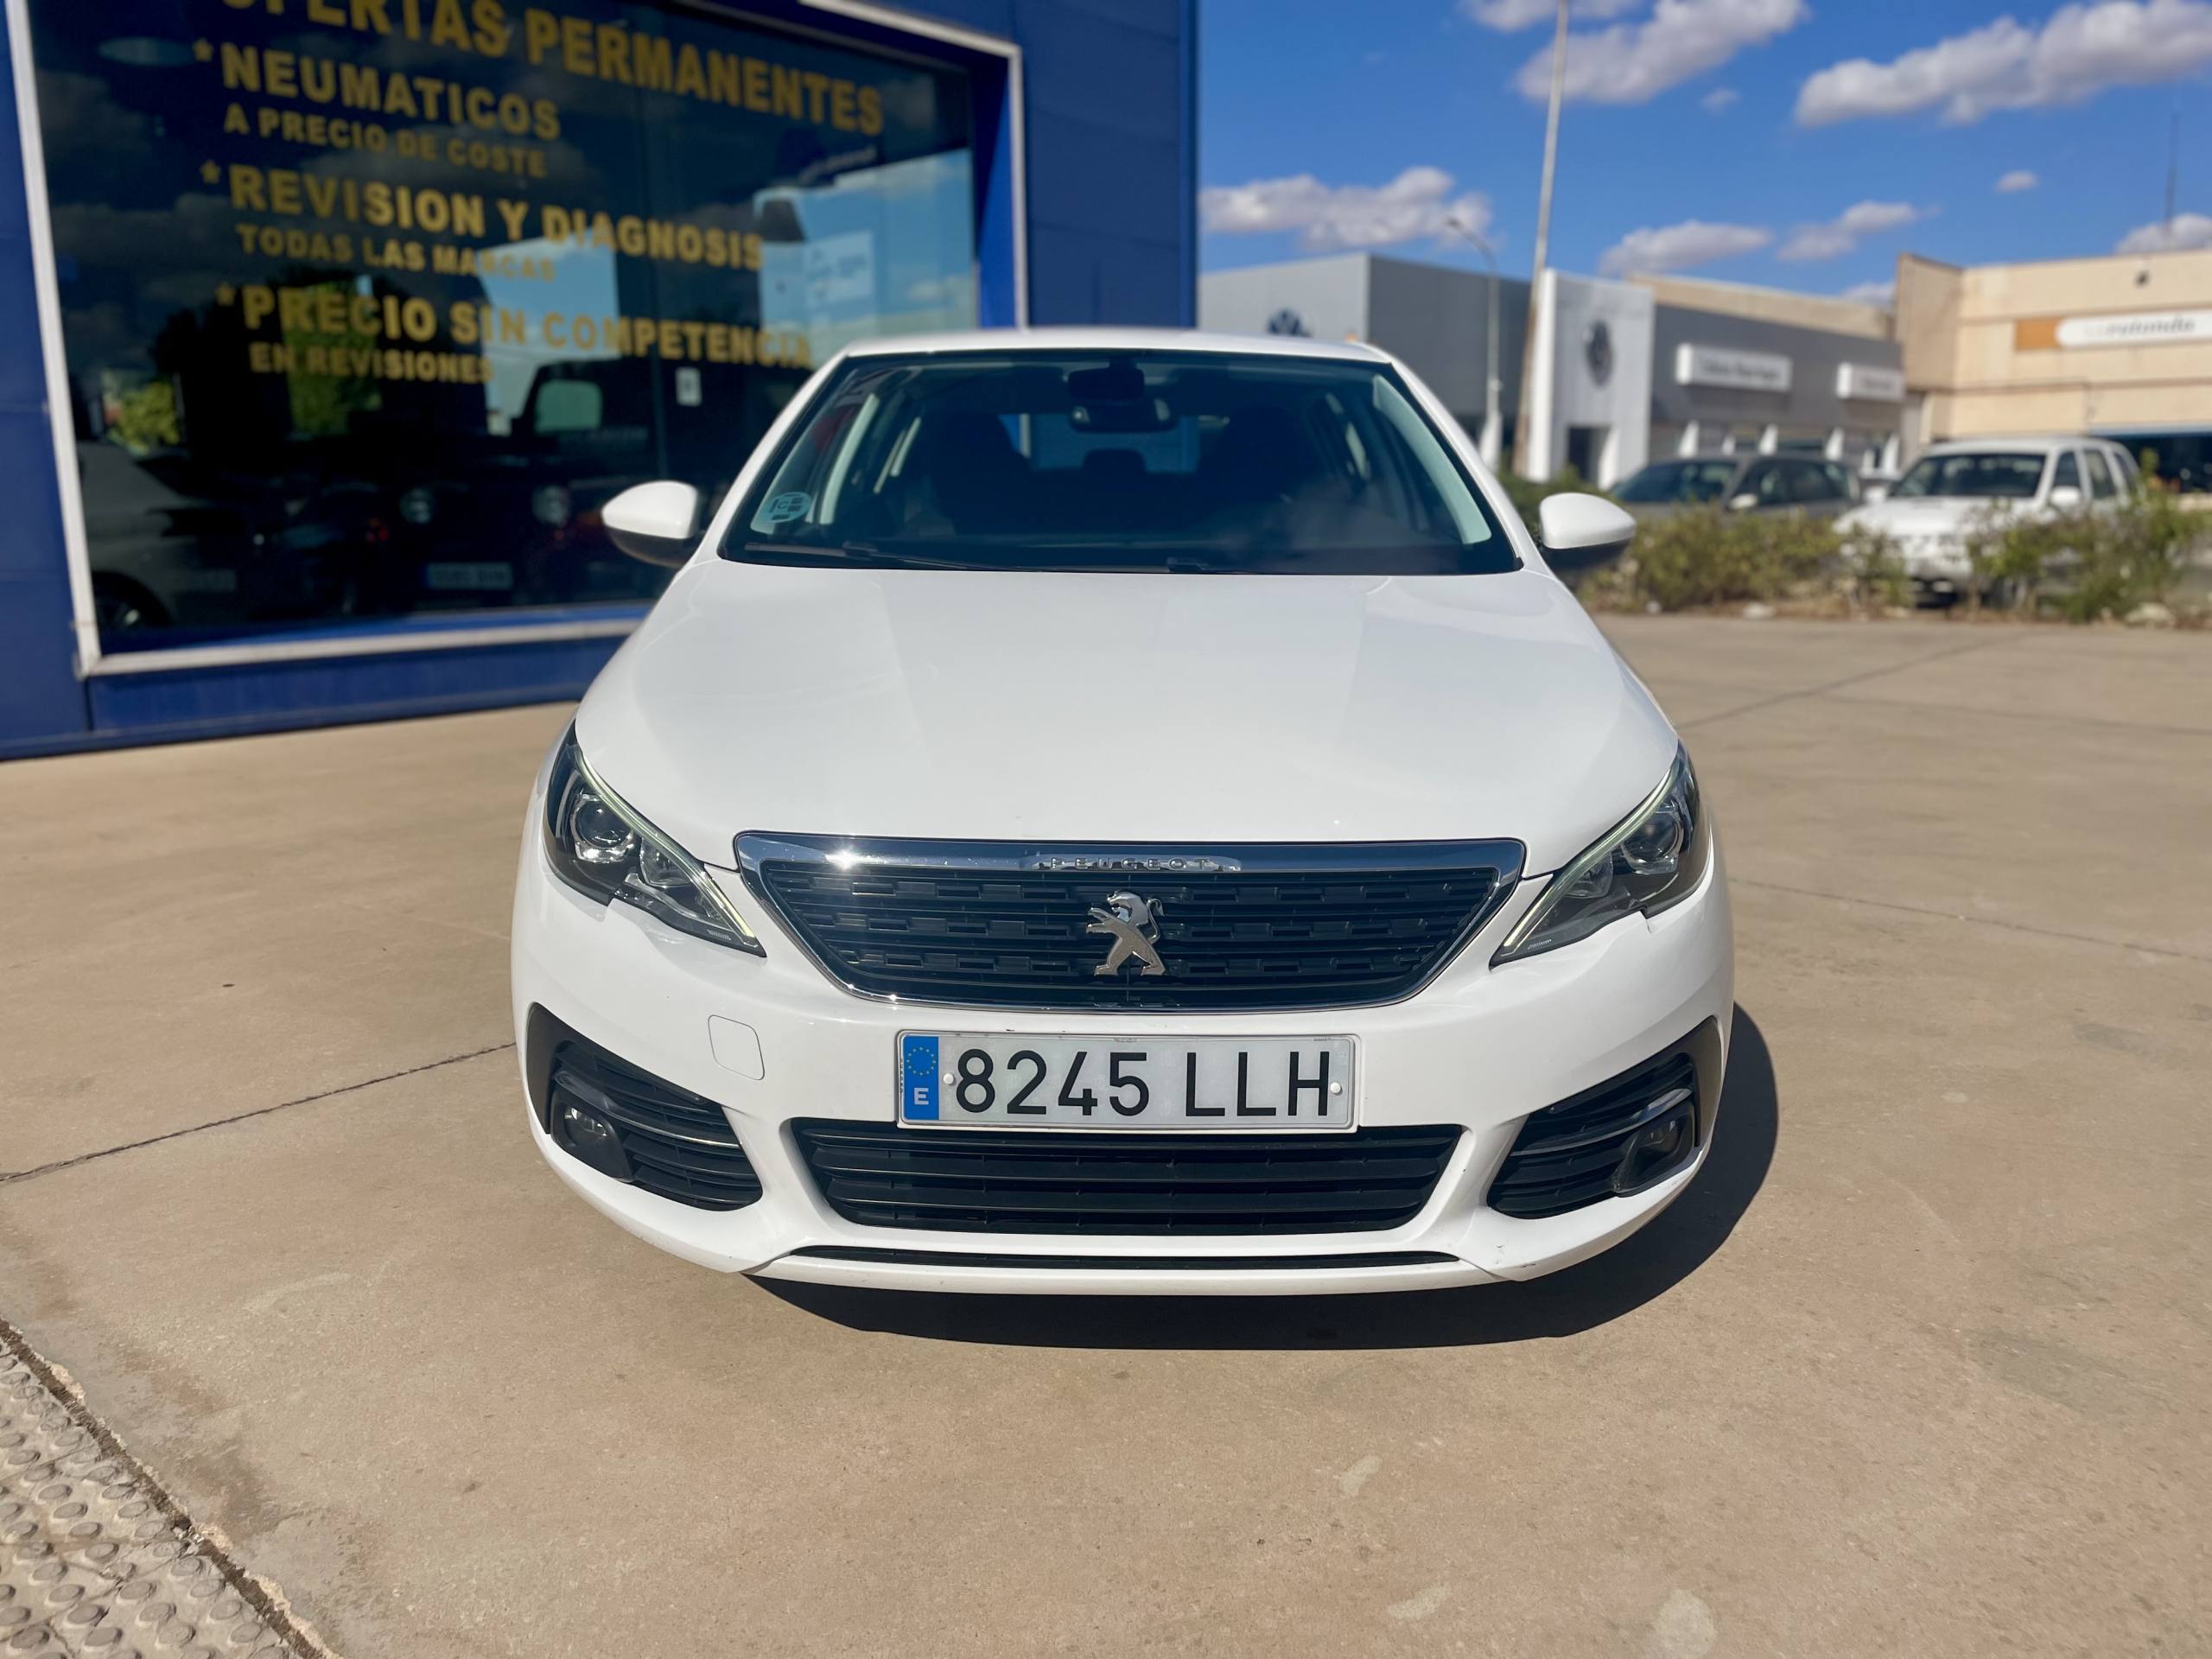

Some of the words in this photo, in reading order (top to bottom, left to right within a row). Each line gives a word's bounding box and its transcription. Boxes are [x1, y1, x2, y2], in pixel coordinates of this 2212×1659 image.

[222, 0, 509, 57] RTAS
[524, 8, 883, 136] PERMANENTES
[224, 103, 249, 134] A
[260, 107, 387, 152] PRECIO
[397, 130, 437, 161] DE
[448, 137, 547, 178] COSTE
[235, 224, 353, 264] TODAS
[364, 238, 425, 272] LAS
[435, 245, 556, 282] MARCAS
[498, 199, 529, 241] Y
[542, 206, 763, 271] DIAGNOSIS
[250, 342, 295, 374] EN
[307, 345, 493, 384] REVISIONES
[450, 301, 524, 346] SIN
[543, 312, 813, 369] COMPETENCIA
[1051, 856, 1211, 870] PEUGEOT
[914, 1087, 929, 1106] E
[956, 1049, 1149, 1116] 8245
[1185, 1052, 1330, 1117] LLH
